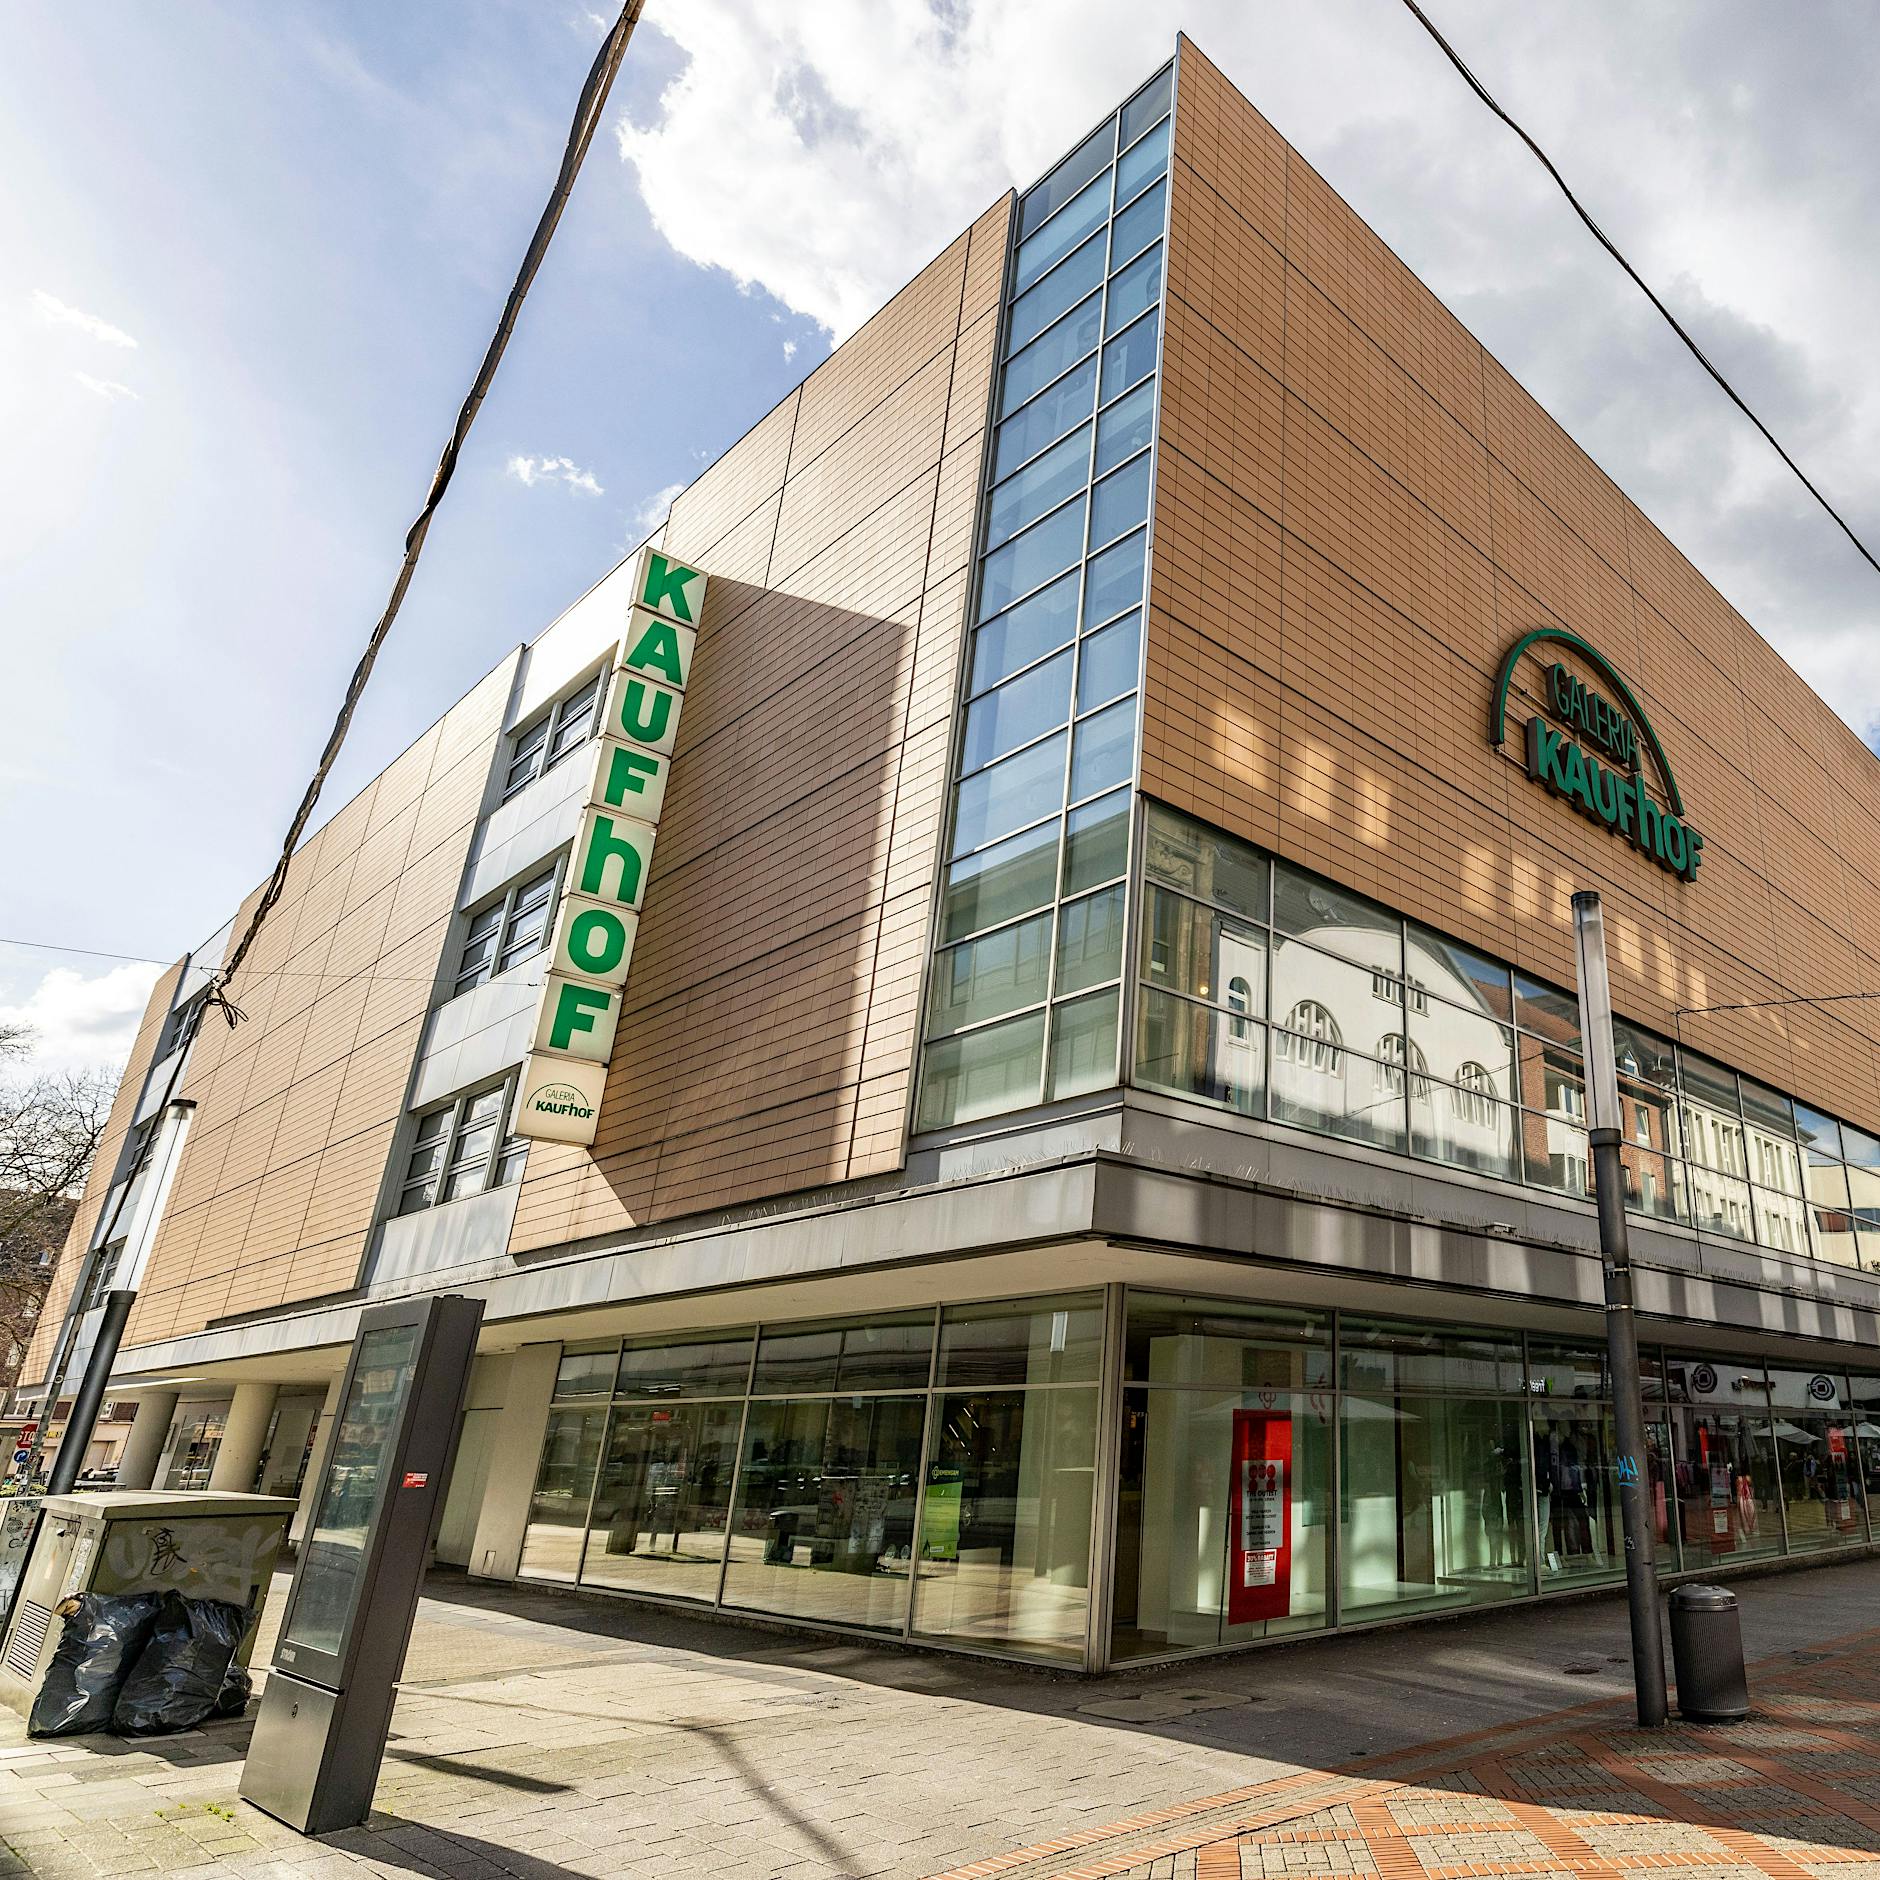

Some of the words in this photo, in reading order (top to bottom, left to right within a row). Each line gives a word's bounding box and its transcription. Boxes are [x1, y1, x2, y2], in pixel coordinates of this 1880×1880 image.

[1546, 661, 1643, 772] GALERIA
[549, 553, 700, 1050] KAUFhOF
[1526, 716, 1704, 883] KAUFhOF
[535, 1100, 595, 1119] KAUFhOF
[545, 1088, 575, 1102] GALERIA
[18, 1430, 36, 1441] STO
